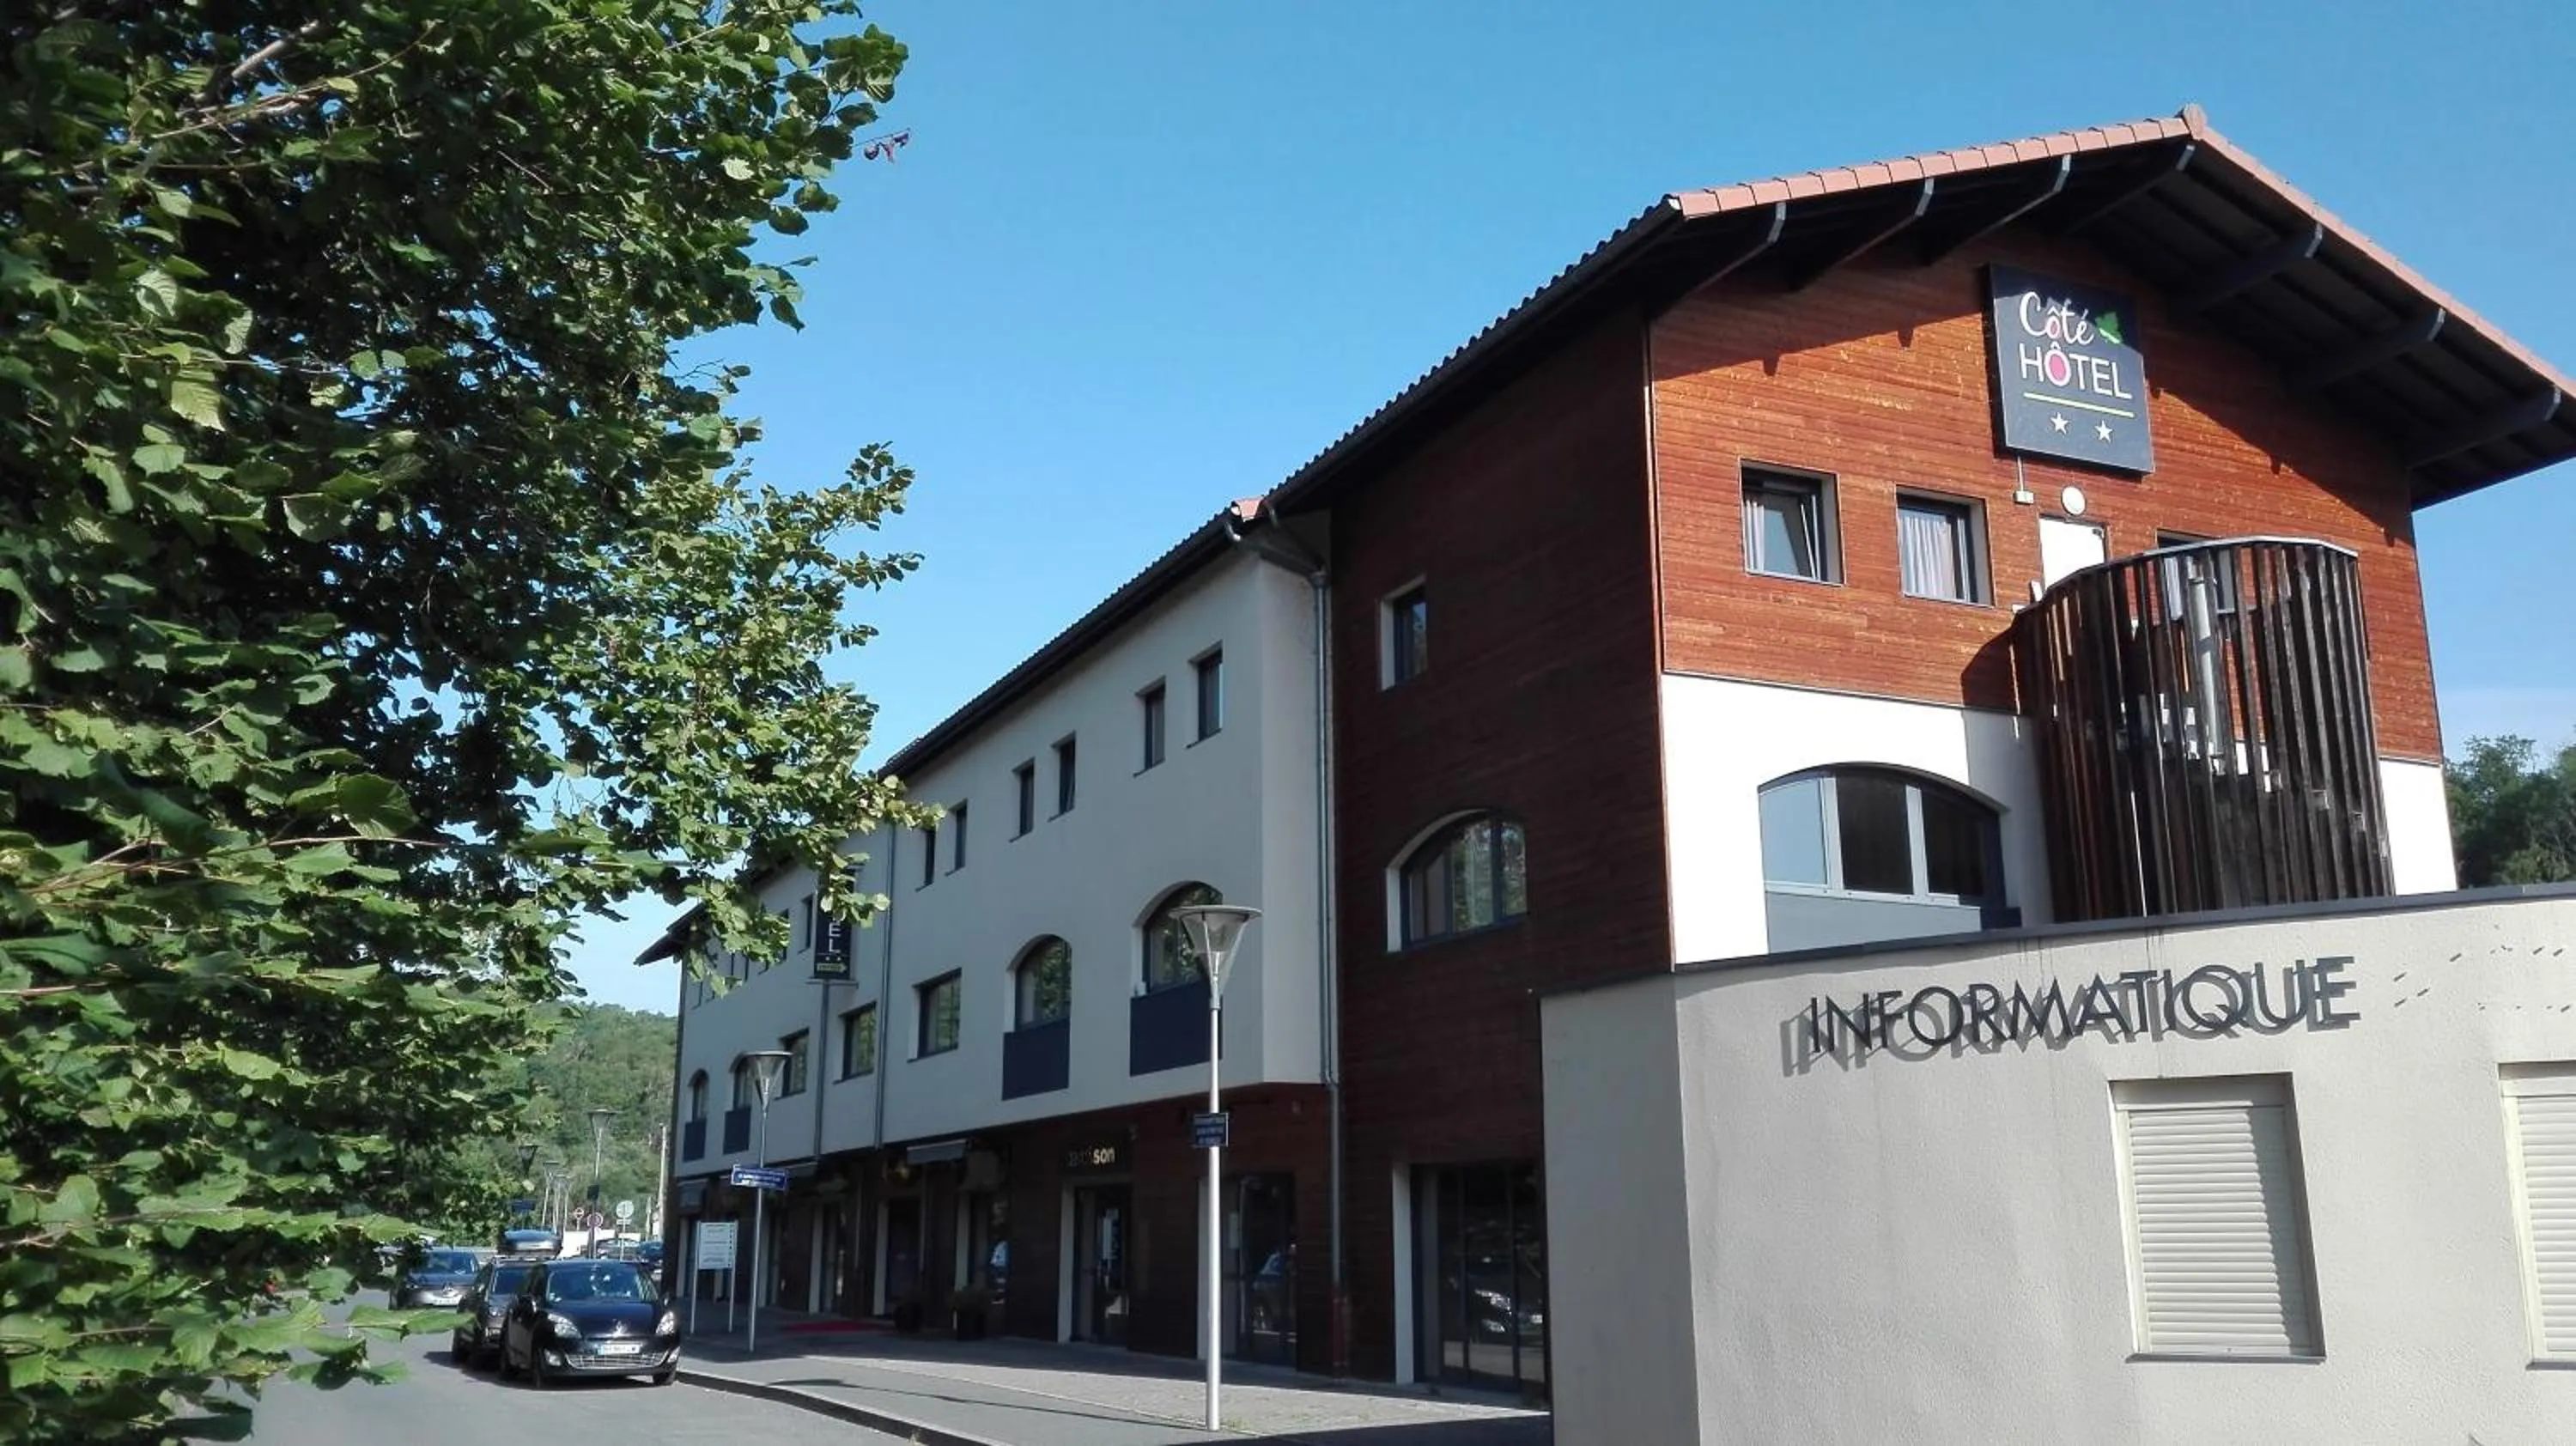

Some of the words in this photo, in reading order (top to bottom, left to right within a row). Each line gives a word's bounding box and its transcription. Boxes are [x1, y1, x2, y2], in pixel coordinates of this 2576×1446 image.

[2020, 291, 2093, 345] Côté
[2019, 341, 2133, 400] HÔTEL
[1810, 956, 2361, 1054] INFORMATIQUE
